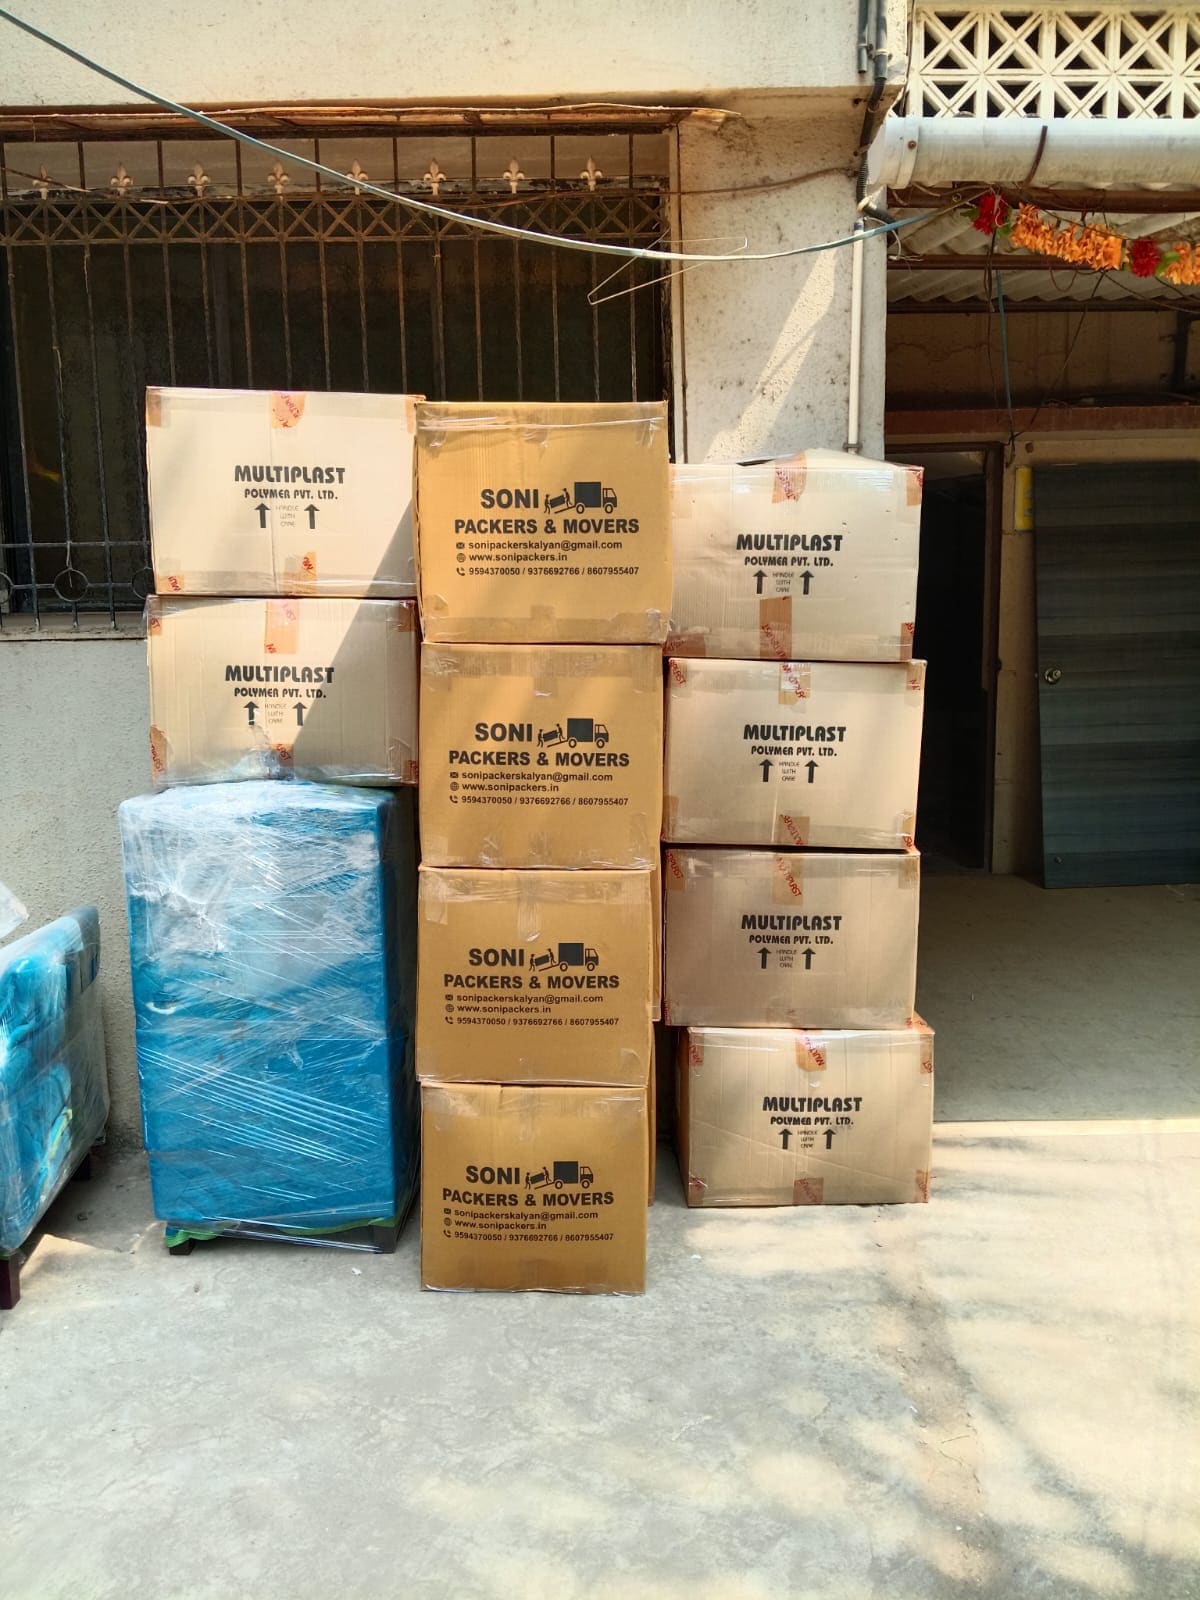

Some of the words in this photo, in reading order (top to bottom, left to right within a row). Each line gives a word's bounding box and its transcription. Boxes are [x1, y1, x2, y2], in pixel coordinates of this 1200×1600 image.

[234, 465, 345, 484] MULTIPLAST
[244, 488, 290, 499] POLYMER
[293, 489, 314, 499] PVT.
[317, 490, 338, 500] LTD.
[480, 488, 539, 509] SONI
[454, 518, 538, 534] PACKERS
[543, 519, 557, 534] &
[563, 518, 640, 534] MOVERS
[468, 540, 623, 551] sonipackerskalyan@gmail.com
[736, 534, 843, 552] MULTIPLAST
[469, 553, 568, 563] www.sonipackers.in
[744, 556, 788, 566] POLYMER
[790, 556, 810, 566] PVT.
[813, 557, 834, 567] LTD.
[468, 567, 520, 576] 9594370050
[527, 567, 580, 576] 9376692766
[587, 566, 640, 575] 8607955407
[225, 665, 335, 683] MULTIPLAST
[234, 687, 279, 698] POLYMER
[282, 688, 302, 698] PVT.
[306, 688, 327, 699] LTD.
[475, 722, 533, 742] SONI
[743, 724, 847, 742] MULTIPLAST
[751, 745, 794, 756] POLYMER
[796, 746, 815, 756] PVT.
[818, 747, 838, 757] LTD.
[449, 750, 531, 766] PACKERS
[536, 752, 549, 766] &
[555, 752, 630, 767] MOVERS
[461, 771, 613, 782] sonipackerskalyan@gmail.com
[462, 783, 559, 793] www.sonipackers.in
[461, 796, 513, 804] 9594370050
[519, 797, 571, 805] 9376692766
[578, 797, 629, 806] 8607955407
[741, 914, 842, 930] MULTIPLAST
[749, 934, 791, 944] POLYMER
[793, 935, 812, 945] PVT.
[815, 936, 834, 945] LTD.
[468, 948, 525, 967] SONI
[443, 973, 523, 989] PACKERS
[528, 975, 541, 989] &
[547, 975, 620, 989] MOVERS
[456, 993, 604, 1004] sonipackerskalyan@gmail.com
[457, 1005, 552, 1014] www.sonipackers.in
[456, 1017, 506, 1025] 9594370050
[512, 1018, 563, 1026] 9376692766
[569, 1018, 619, 1026] 8607955407
[762, 1096, 862, 1112] MULTIPLAST
[770, 1116, 811, 1125] POLYMER
[814, 1116, 832, 1125] PVT.
[835, 1116, 854, 1125] LTD.
[465, 1165, 520, 1185] SONI
[442, 1188, 519, 1206] PACKERS
[524, 1194, 536, 1206] &
[542, 1191, 614, 1206] MOVERS
[454, 1208, 598, 1221] sonipackerskalyan@gmail.com
[455, 1219, 547, 1230] www.sonipackers.in
